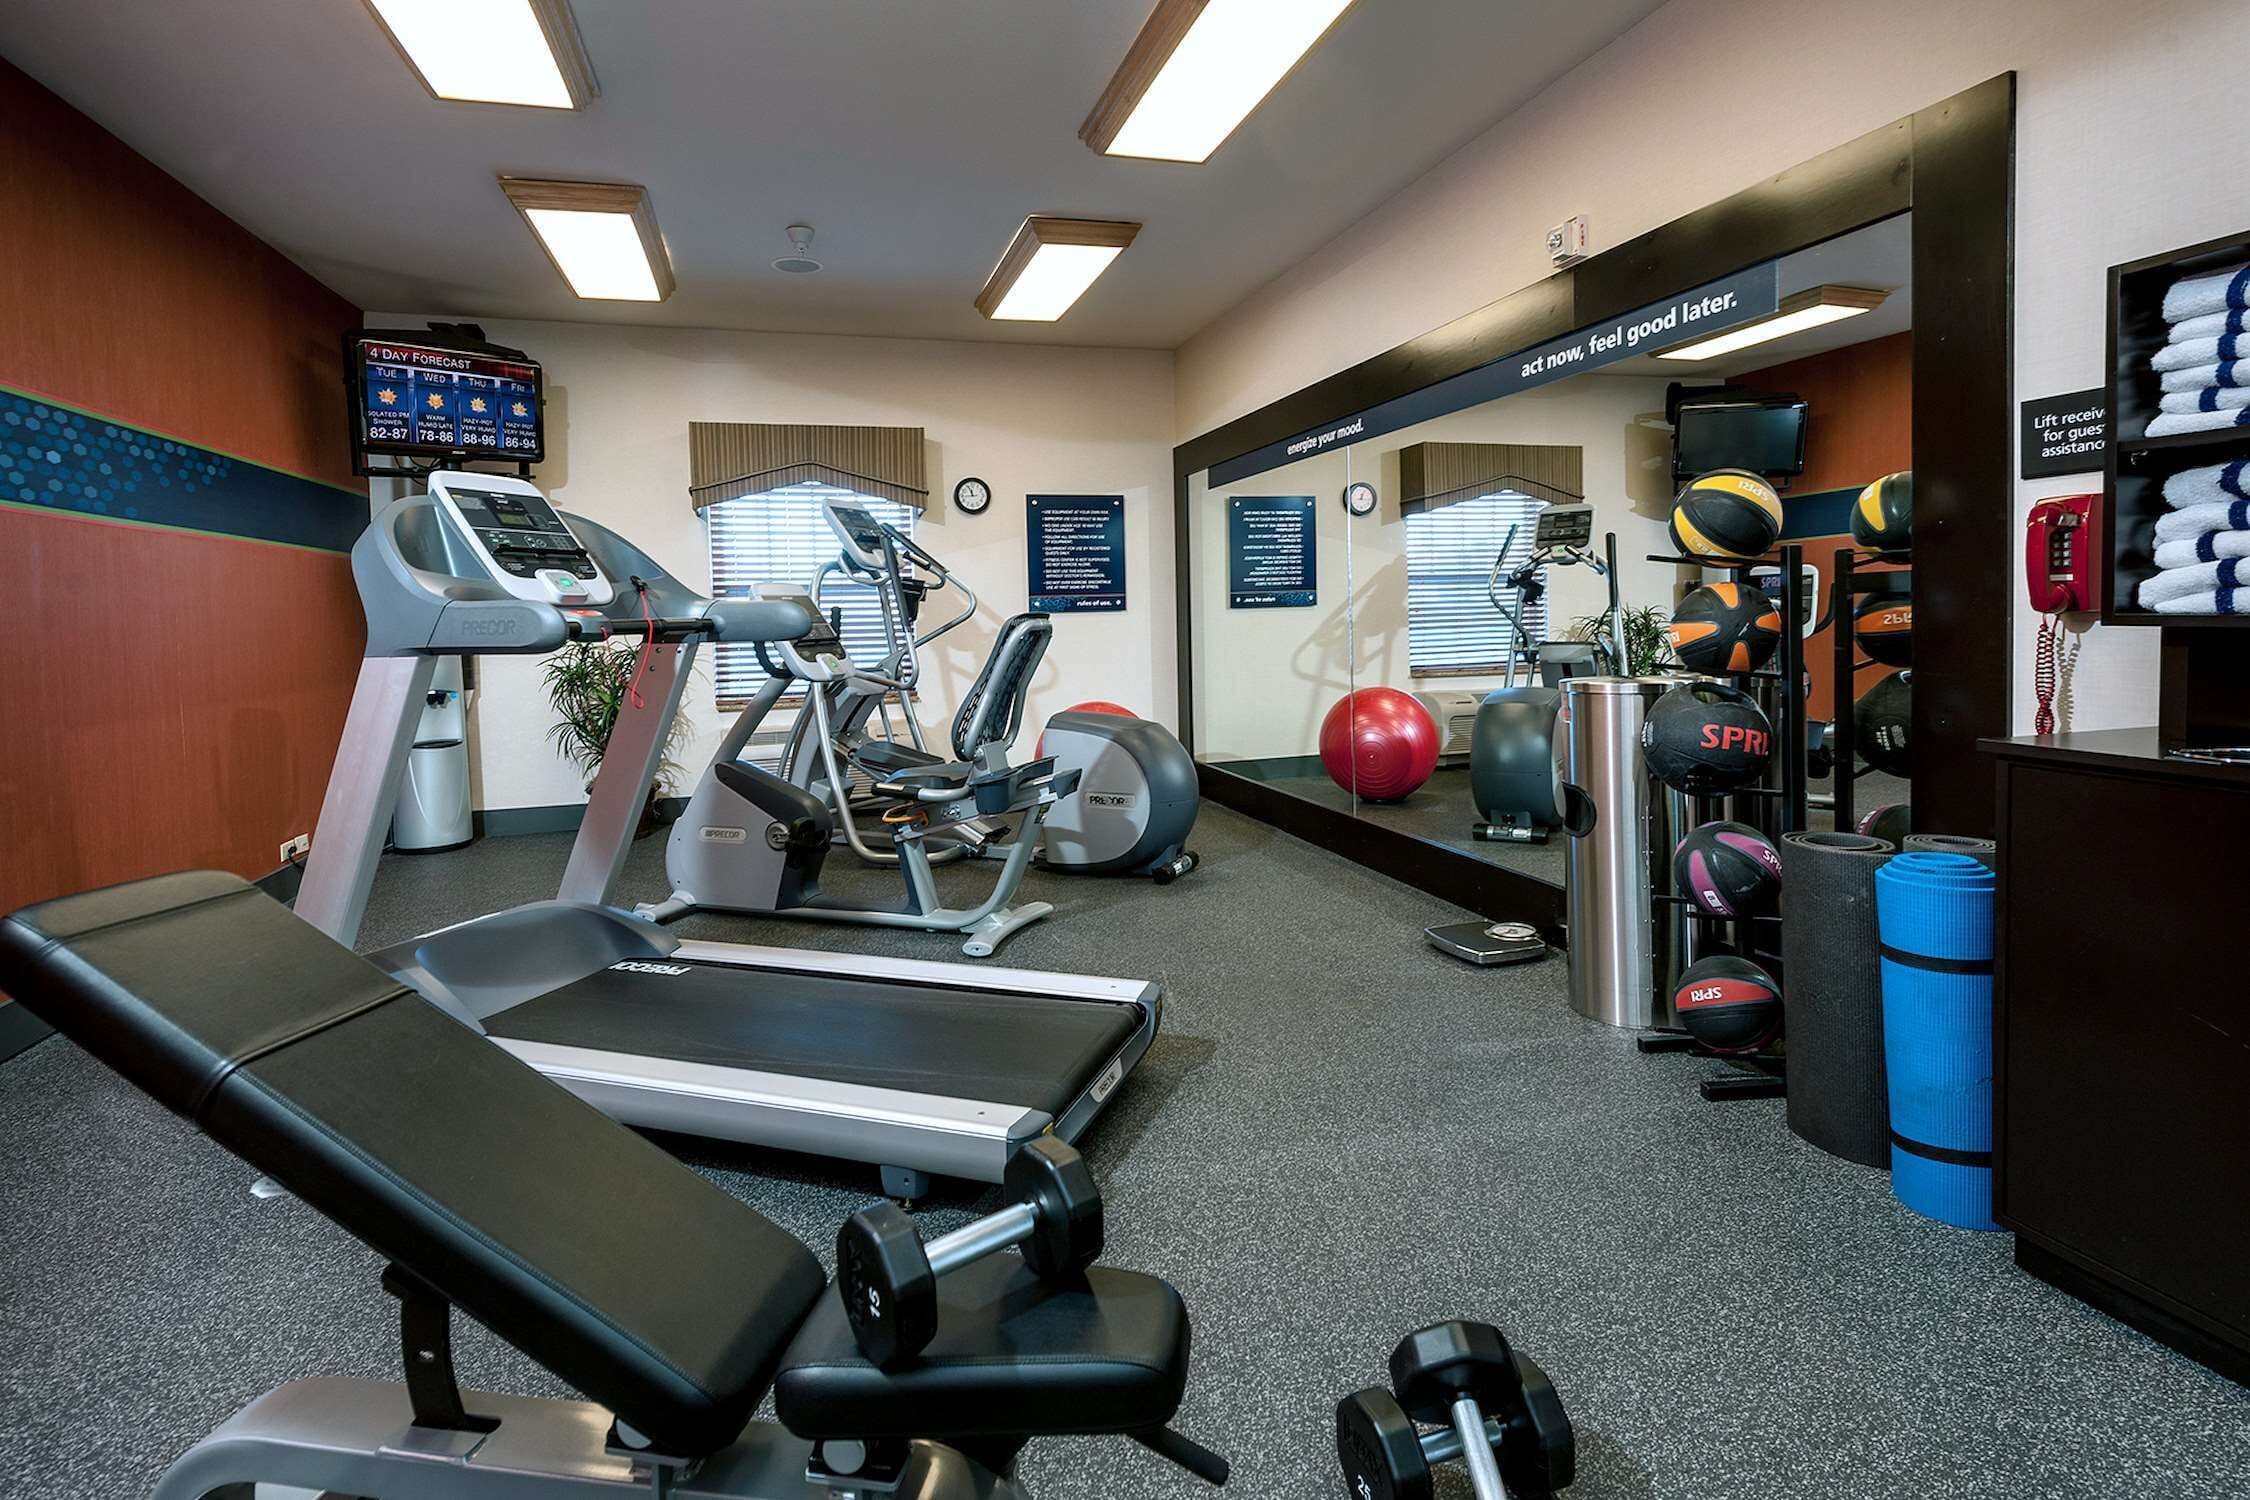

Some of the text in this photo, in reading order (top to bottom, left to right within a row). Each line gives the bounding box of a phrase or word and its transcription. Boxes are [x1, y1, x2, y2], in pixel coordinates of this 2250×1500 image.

[1520, 290, 1737, 378] act now, feel good later.
[369, 348, 472, 370] 4 DAY FORECAST
[375, 367, 397, 378] TUE
[423, 372, 446, 384] WED
[468, 378, 487, 388] THU
[511, 383, 525, 392] FRI
[373, 418, 403, 426] SHOWER
[2034, 407, 2105, 429] Lift receiv
[369, 427, 408, 439] 82-87
[420, 430, 454, 442] 78-86
[463, 433, 496, 446] 88-96
[1287, 418, 1364, 456] energize your mood.
[2043, 424, 2105, 443] for gues
[505, 437, 536, 449] 86-94
[462, 619, 516, 635] PRECOR
[1700, 723, 1768, 756] SPRI
[1763, 850, 1783, 877] SPR
[1690, 987, 1722, 1002] SPRI
